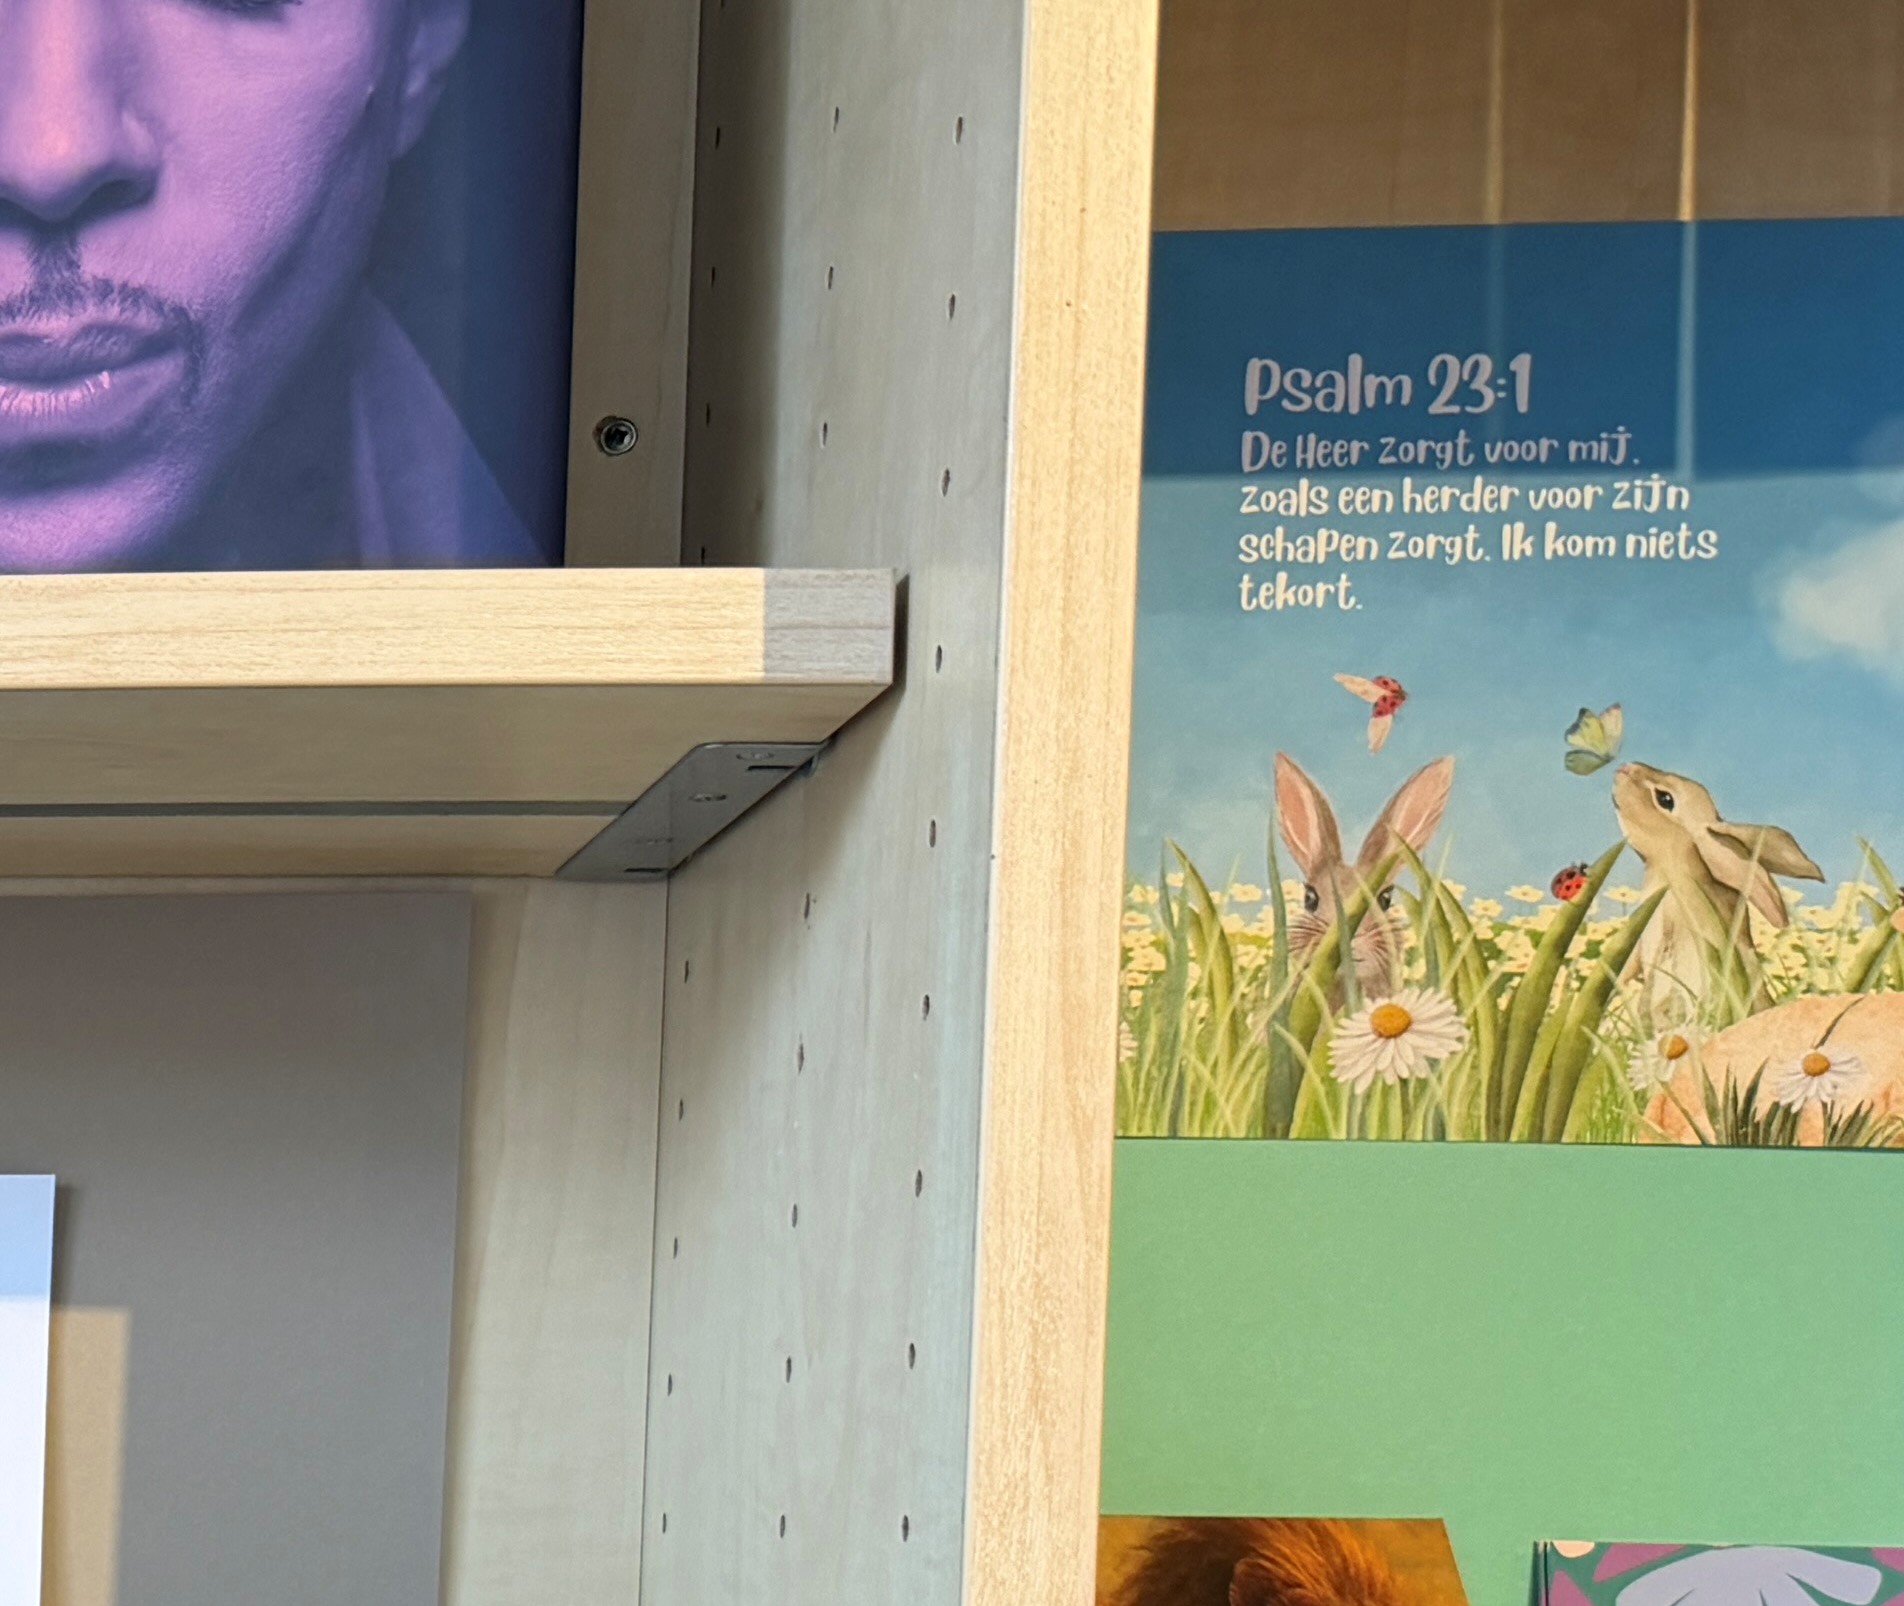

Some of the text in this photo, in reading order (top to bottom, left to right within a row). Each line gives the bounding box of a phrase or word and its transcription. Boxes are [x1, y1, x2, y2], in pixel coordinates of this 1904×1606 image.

[1245, 353, 1531, 415] Psalm 23:1
[1242, 431, 1287, 473] De
[1296, 433, 1369, 469] Heer
[1378, 429, 1475, 470] zorgt
[1485, 437, 1559, 463] voor
[1240, 474, 1689, 517] zoals een herder voor zijn
[1239, 521, 1718, 565] schapen zorgt. Ik kom niets
[1239, 571, 1362, 610] tekort.
